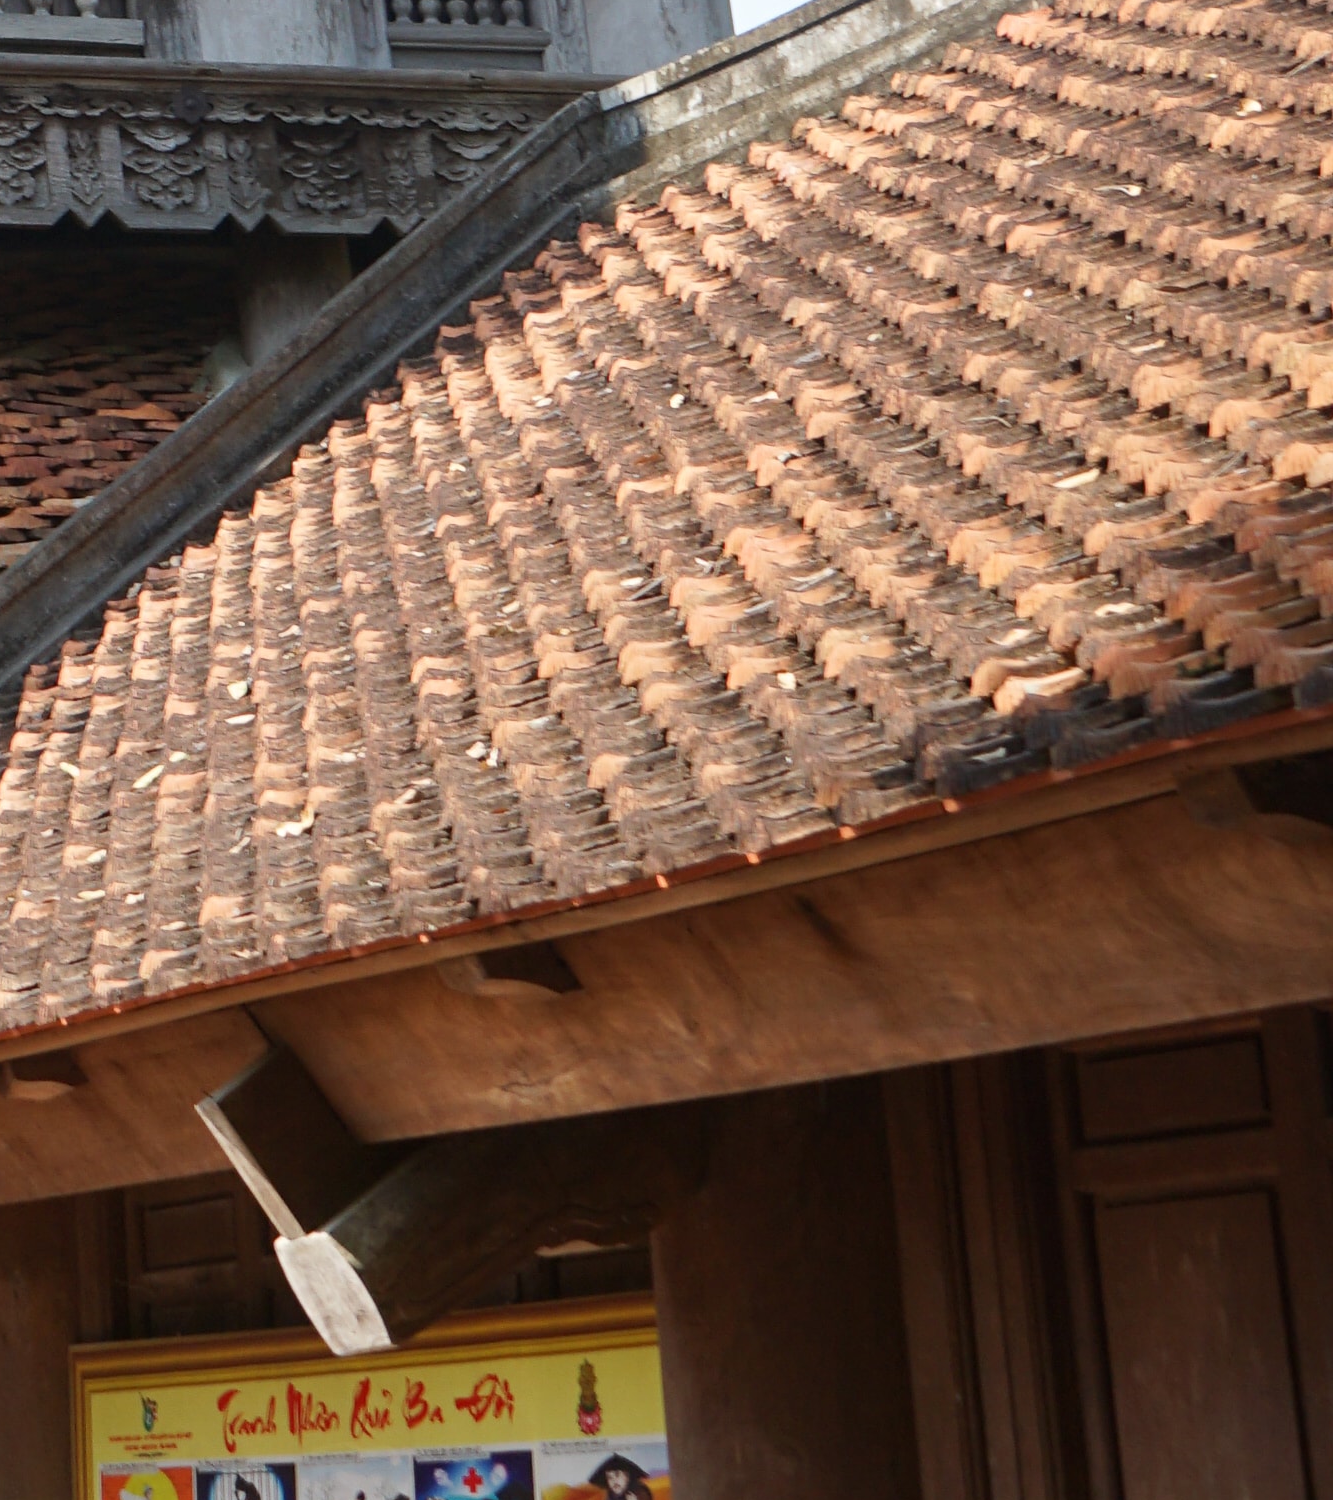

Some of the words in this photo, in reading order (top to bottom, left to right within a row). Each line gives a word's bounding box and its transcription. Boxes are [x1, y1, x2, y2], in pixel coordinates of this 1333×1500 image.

[217, 1389, 276, 1453] Tranh
[286, 1382, 340, 1448] Nhân
[351, 1376, 393, 1439] Quả
[403, 1377, 445, 1429] Ba
